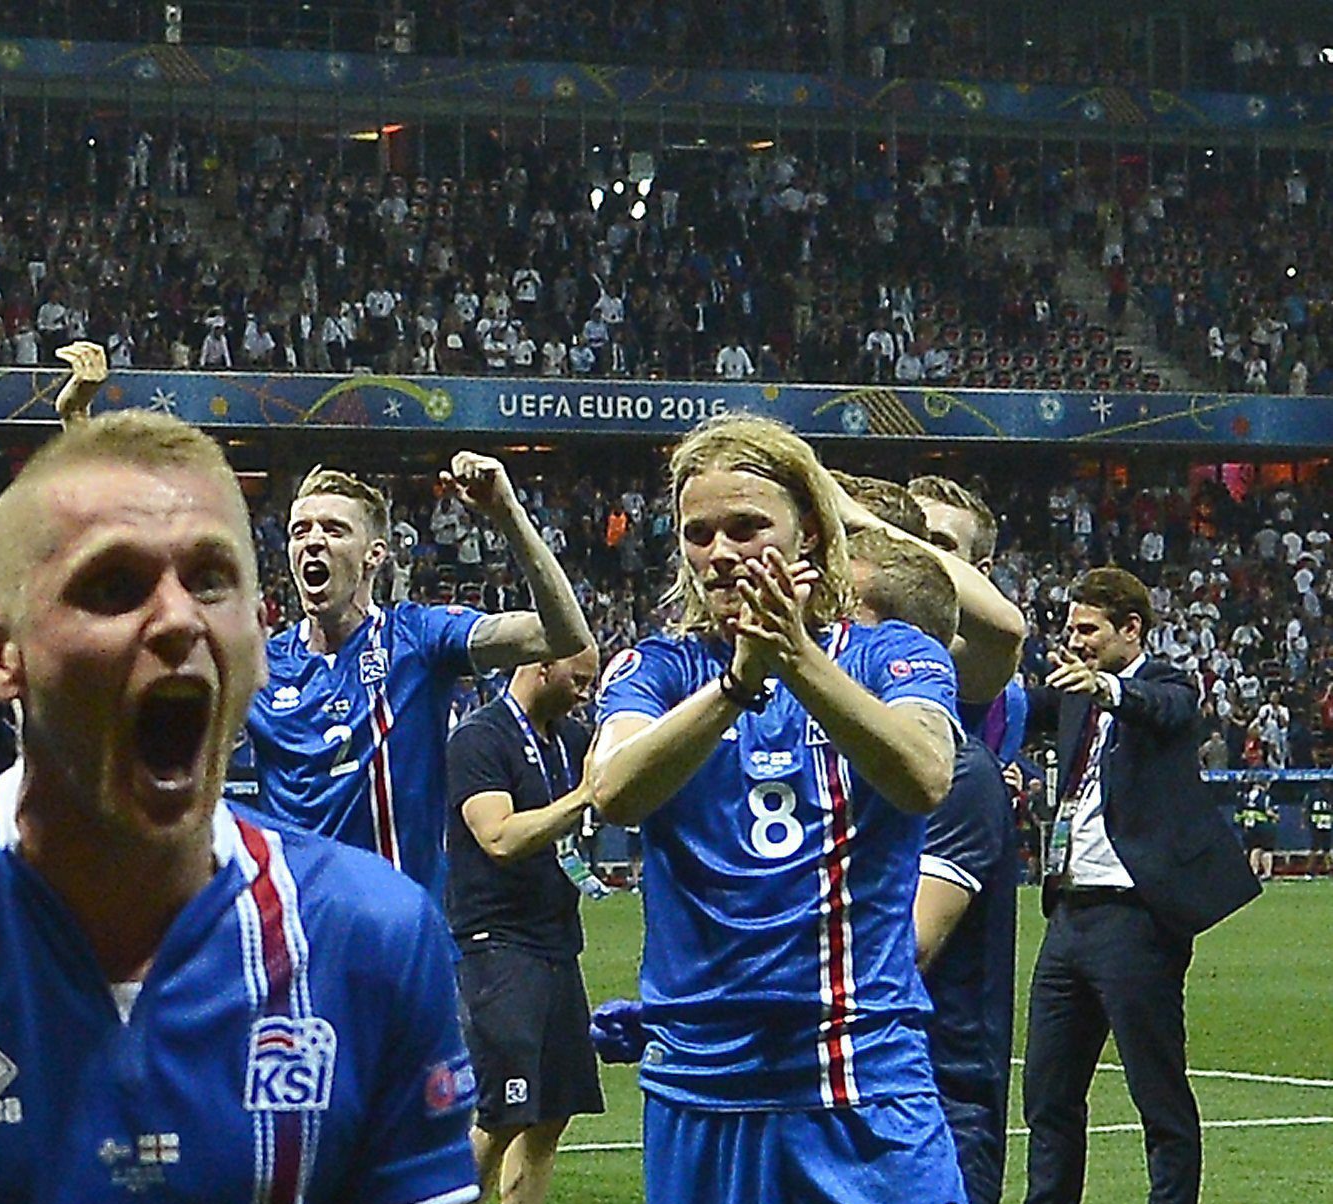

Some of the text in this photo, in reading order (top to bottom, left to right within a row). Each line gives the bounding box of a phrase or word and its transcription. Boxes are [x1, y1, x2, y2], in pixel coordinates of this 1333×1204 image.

[499, 394, 572, 418] UEFA
[579, 395, 653, 420] EURO
[322, 725, 360, 777] 2
[748, 781, 804, 859] 8
